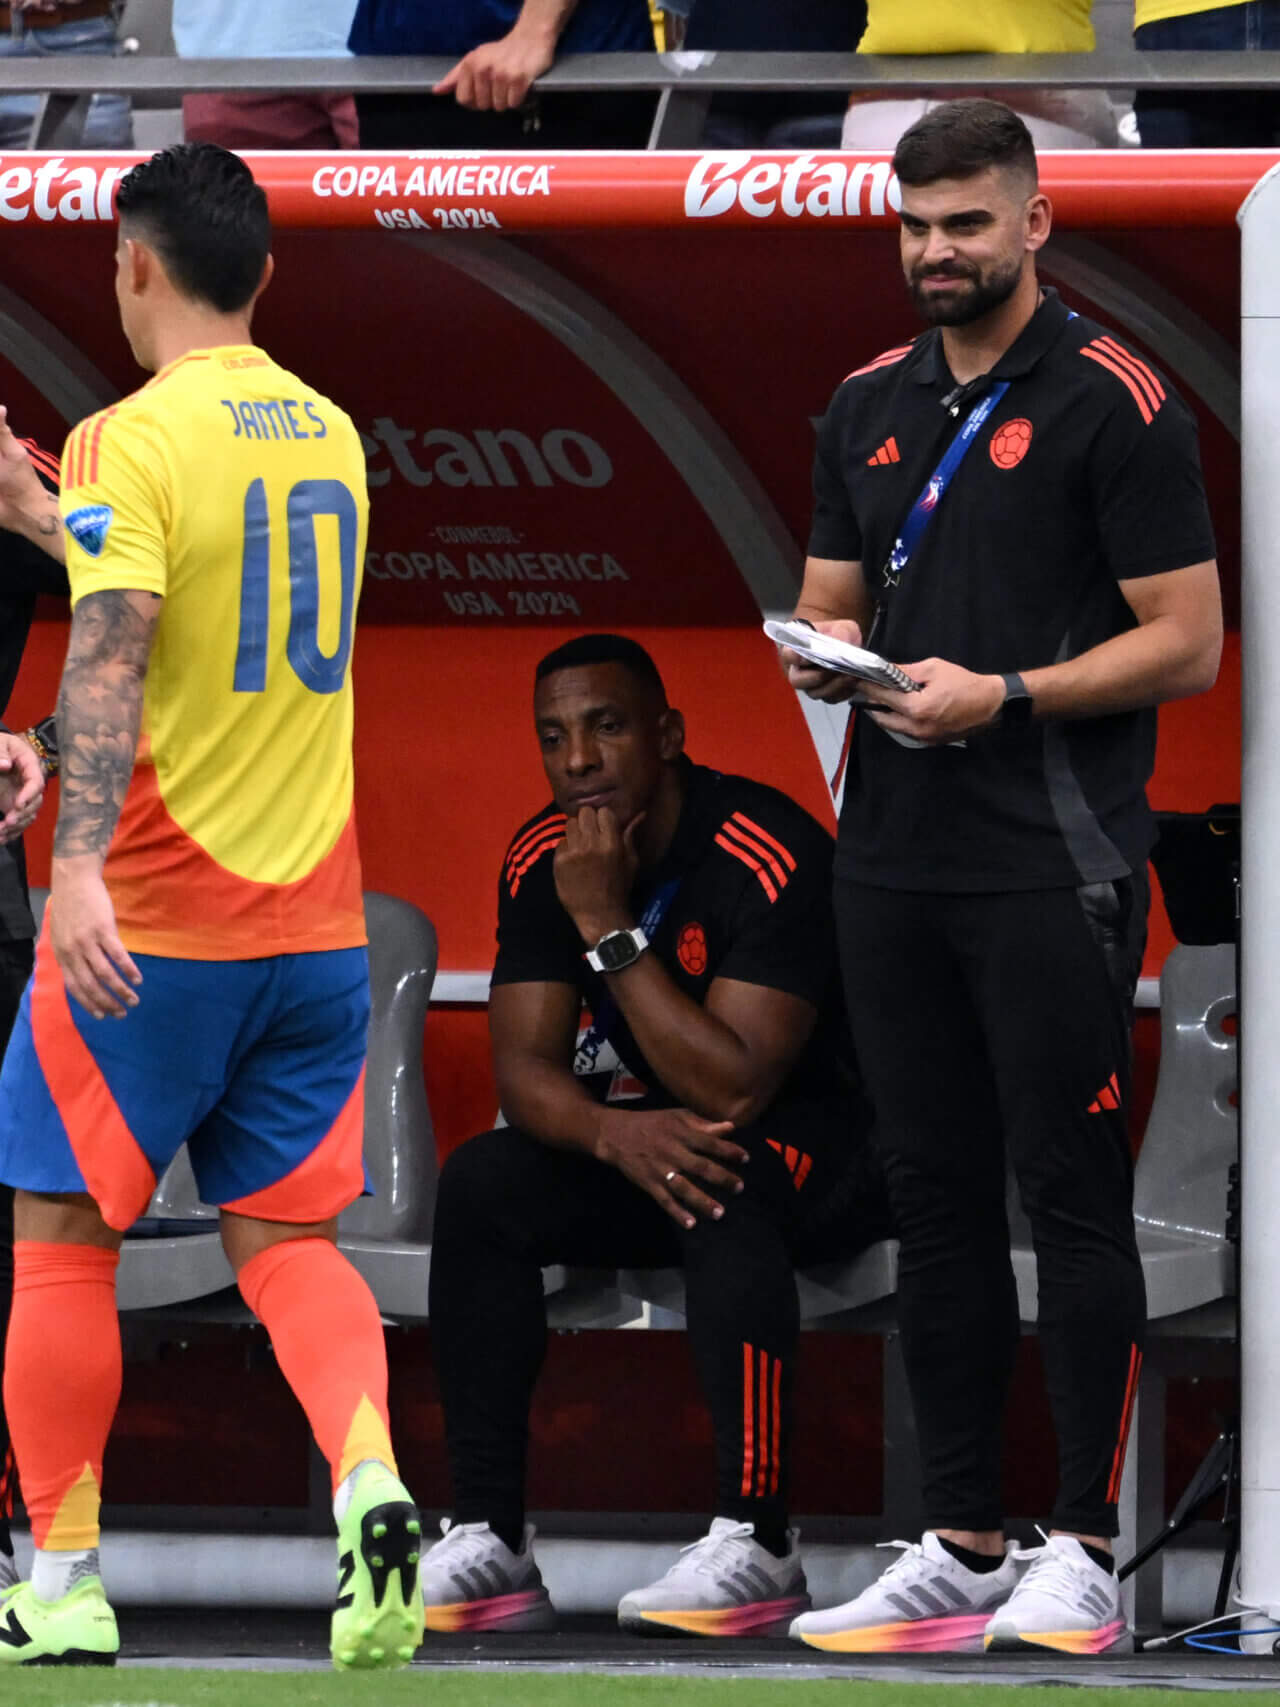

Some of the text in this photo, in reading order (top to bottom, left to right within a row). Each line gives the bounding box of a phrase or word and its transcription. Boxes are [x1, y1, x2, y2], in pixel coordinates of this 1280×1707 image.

[312, 165, 551, 197] COPA AMERICA
[374, 208, 502, 230] USA 2024
[221, 399, 327, 440] JAMES
[361, 416, 614, 488] tano
[365, 552, 631, 581] COPA AMERICA
[232, 477, 357, 694] 10
[443, 591, 583, 616] USA 2024
